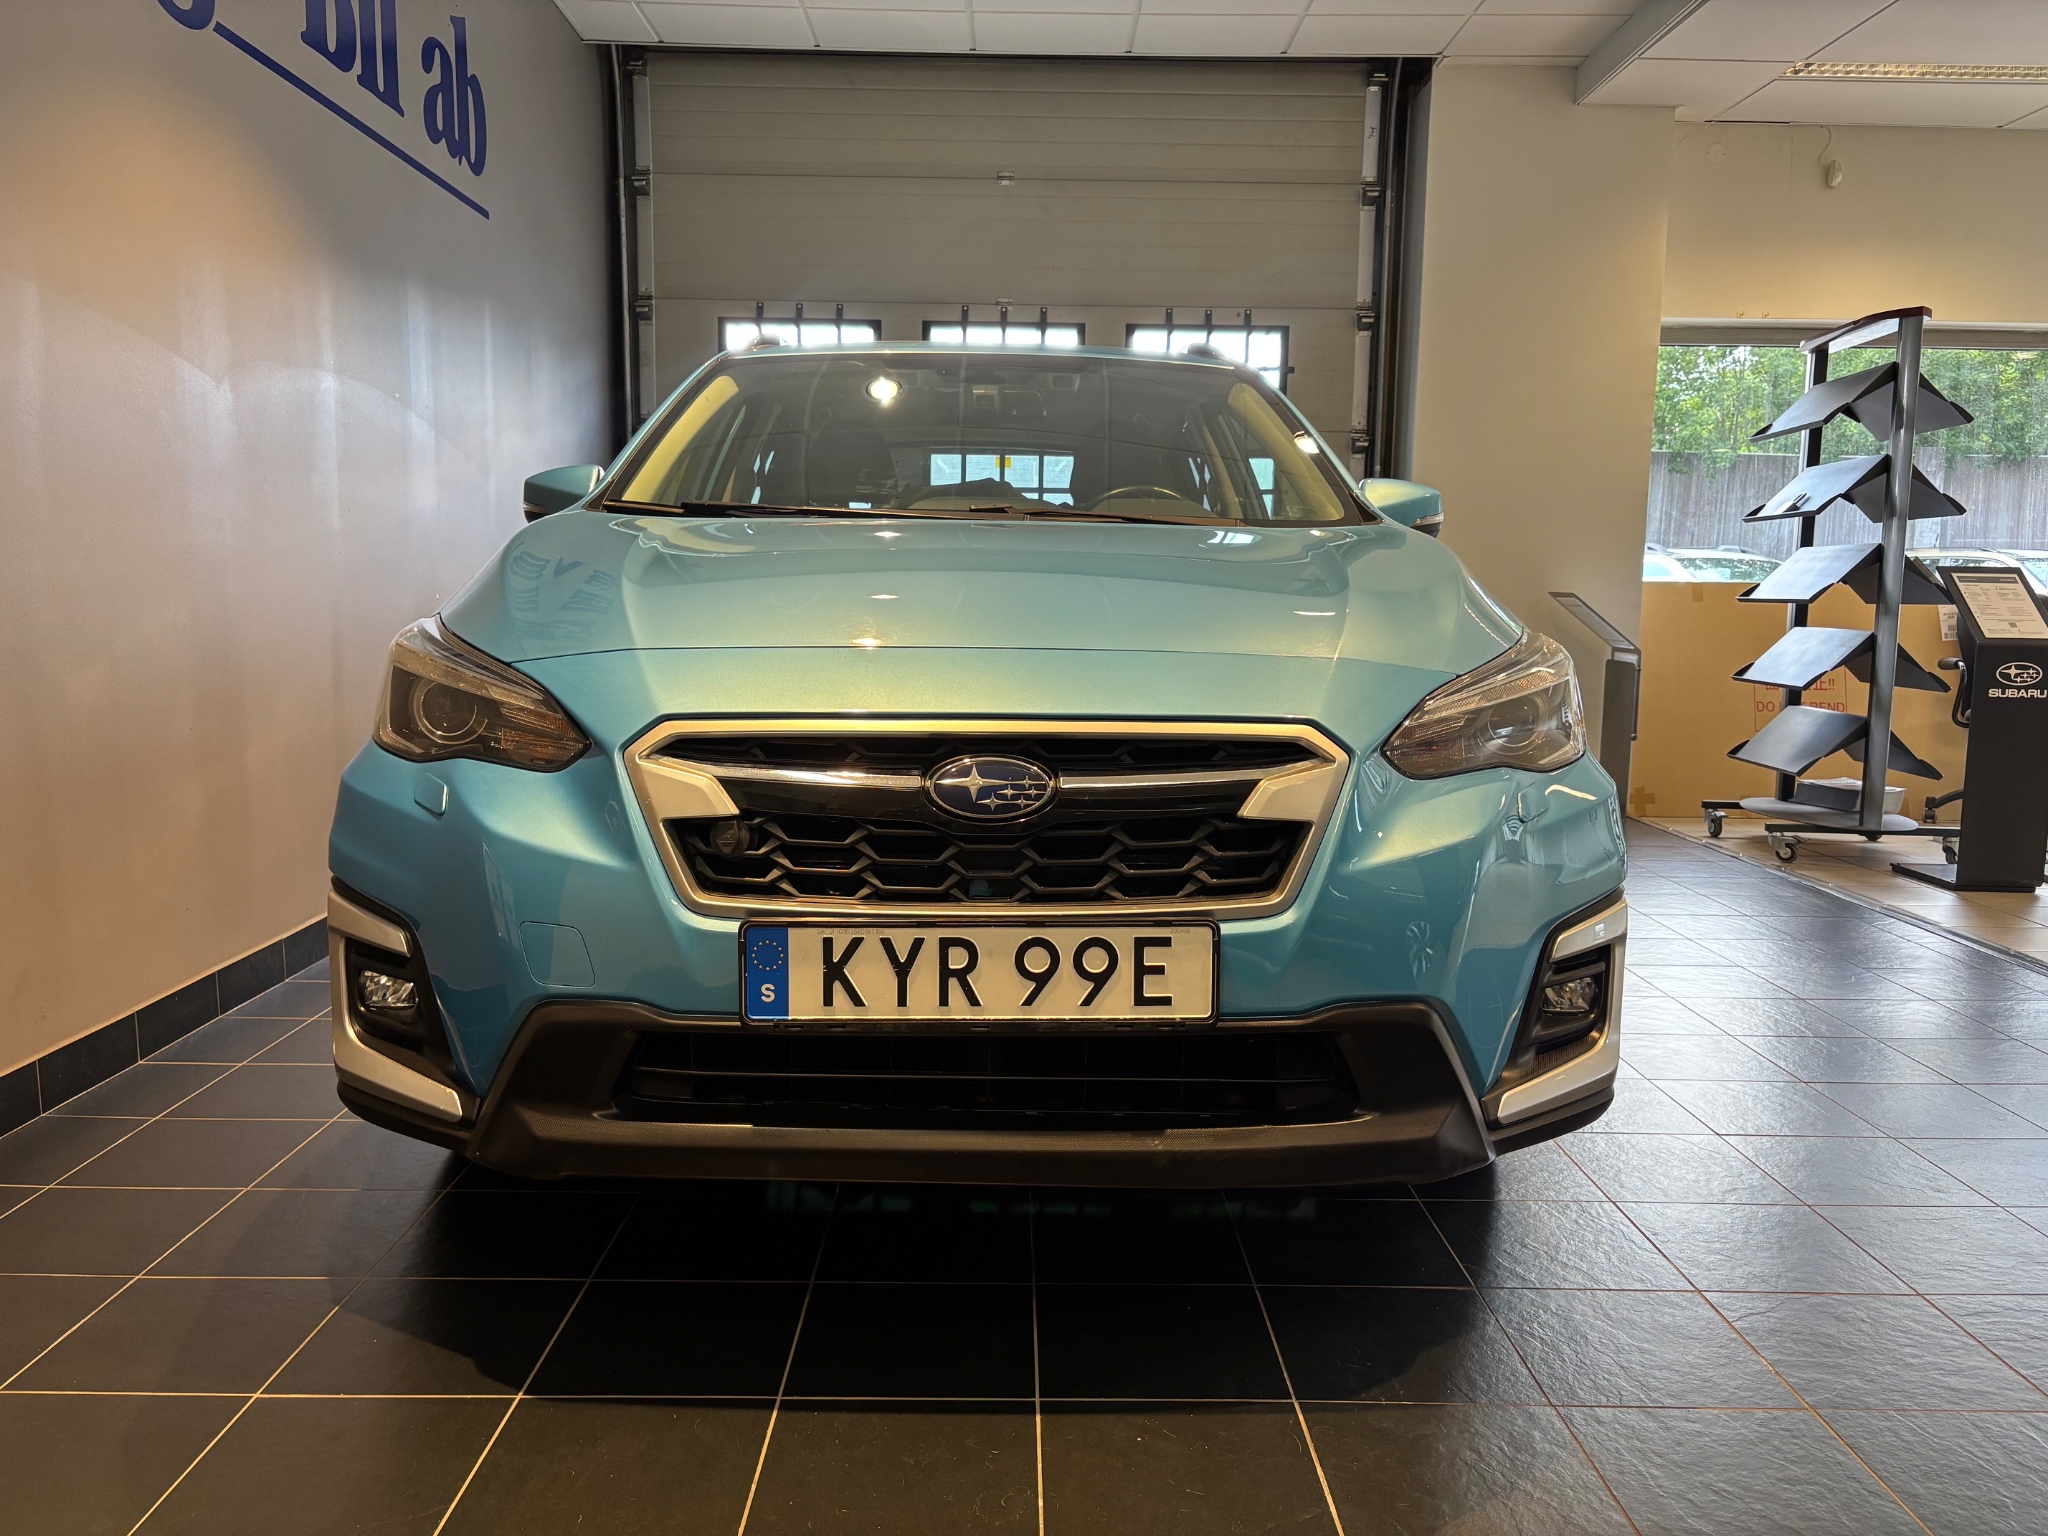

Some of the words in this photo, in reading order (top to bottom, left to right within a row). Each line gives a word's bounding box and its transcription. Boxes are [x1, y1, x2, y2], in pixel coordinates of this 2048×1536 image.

[421, 15, 488, 176] ab
[1988, 688, 2048, 698] SUBARU
[1756, 701, 1775, 712] DO
[822, 936, 984, 1008] KYR
[1013, 936, 1174, 1008] 99E
[760, 982, 776, 1003] S
